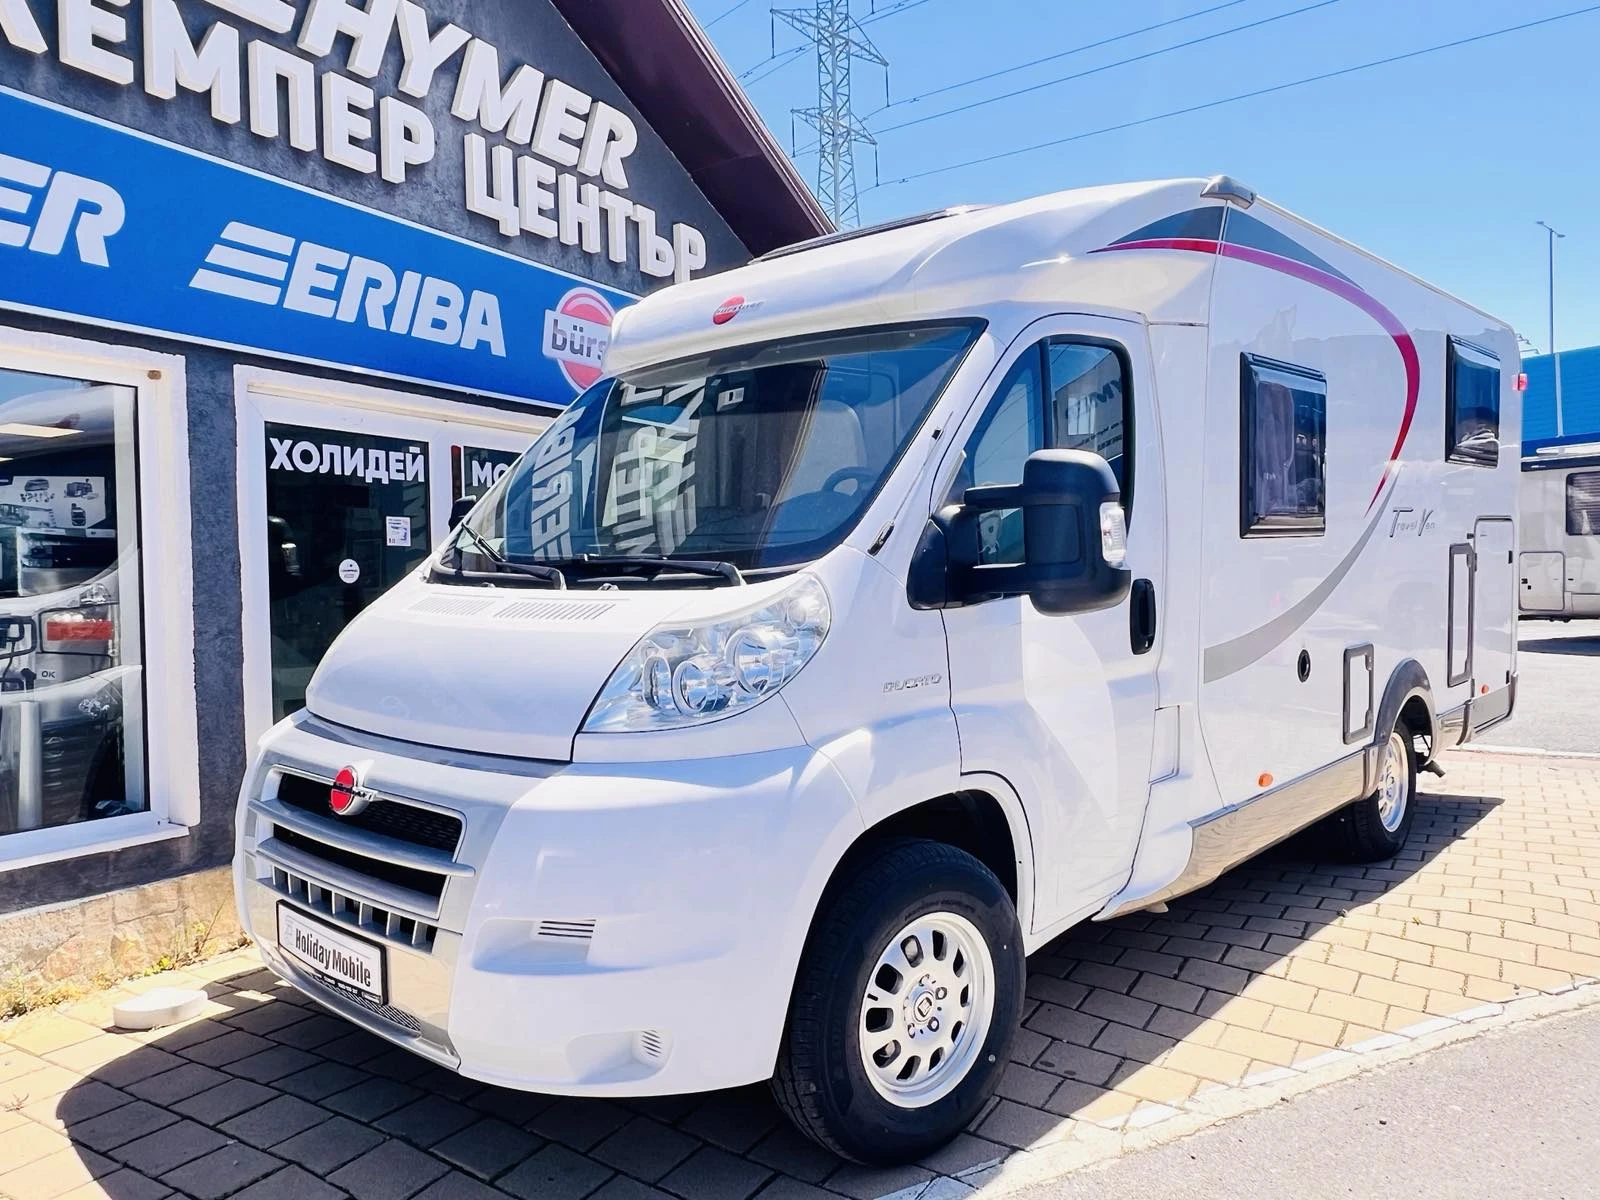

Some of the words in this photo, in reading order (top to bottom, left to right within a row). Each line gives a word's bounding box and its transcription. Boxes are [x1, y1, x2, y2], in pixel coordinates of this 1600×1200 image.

[0, 0, 435, 184] ЕМПЕР
[464, 132, 706, 283] ЦЕНТЪР
[282, 241, 506, 358] ERIBA
[268, 437, 426, 485] ХОЛИДЕЙ
[295, 923, 332, 971] Holiday
[332, 948, 371, 988] Mobile
